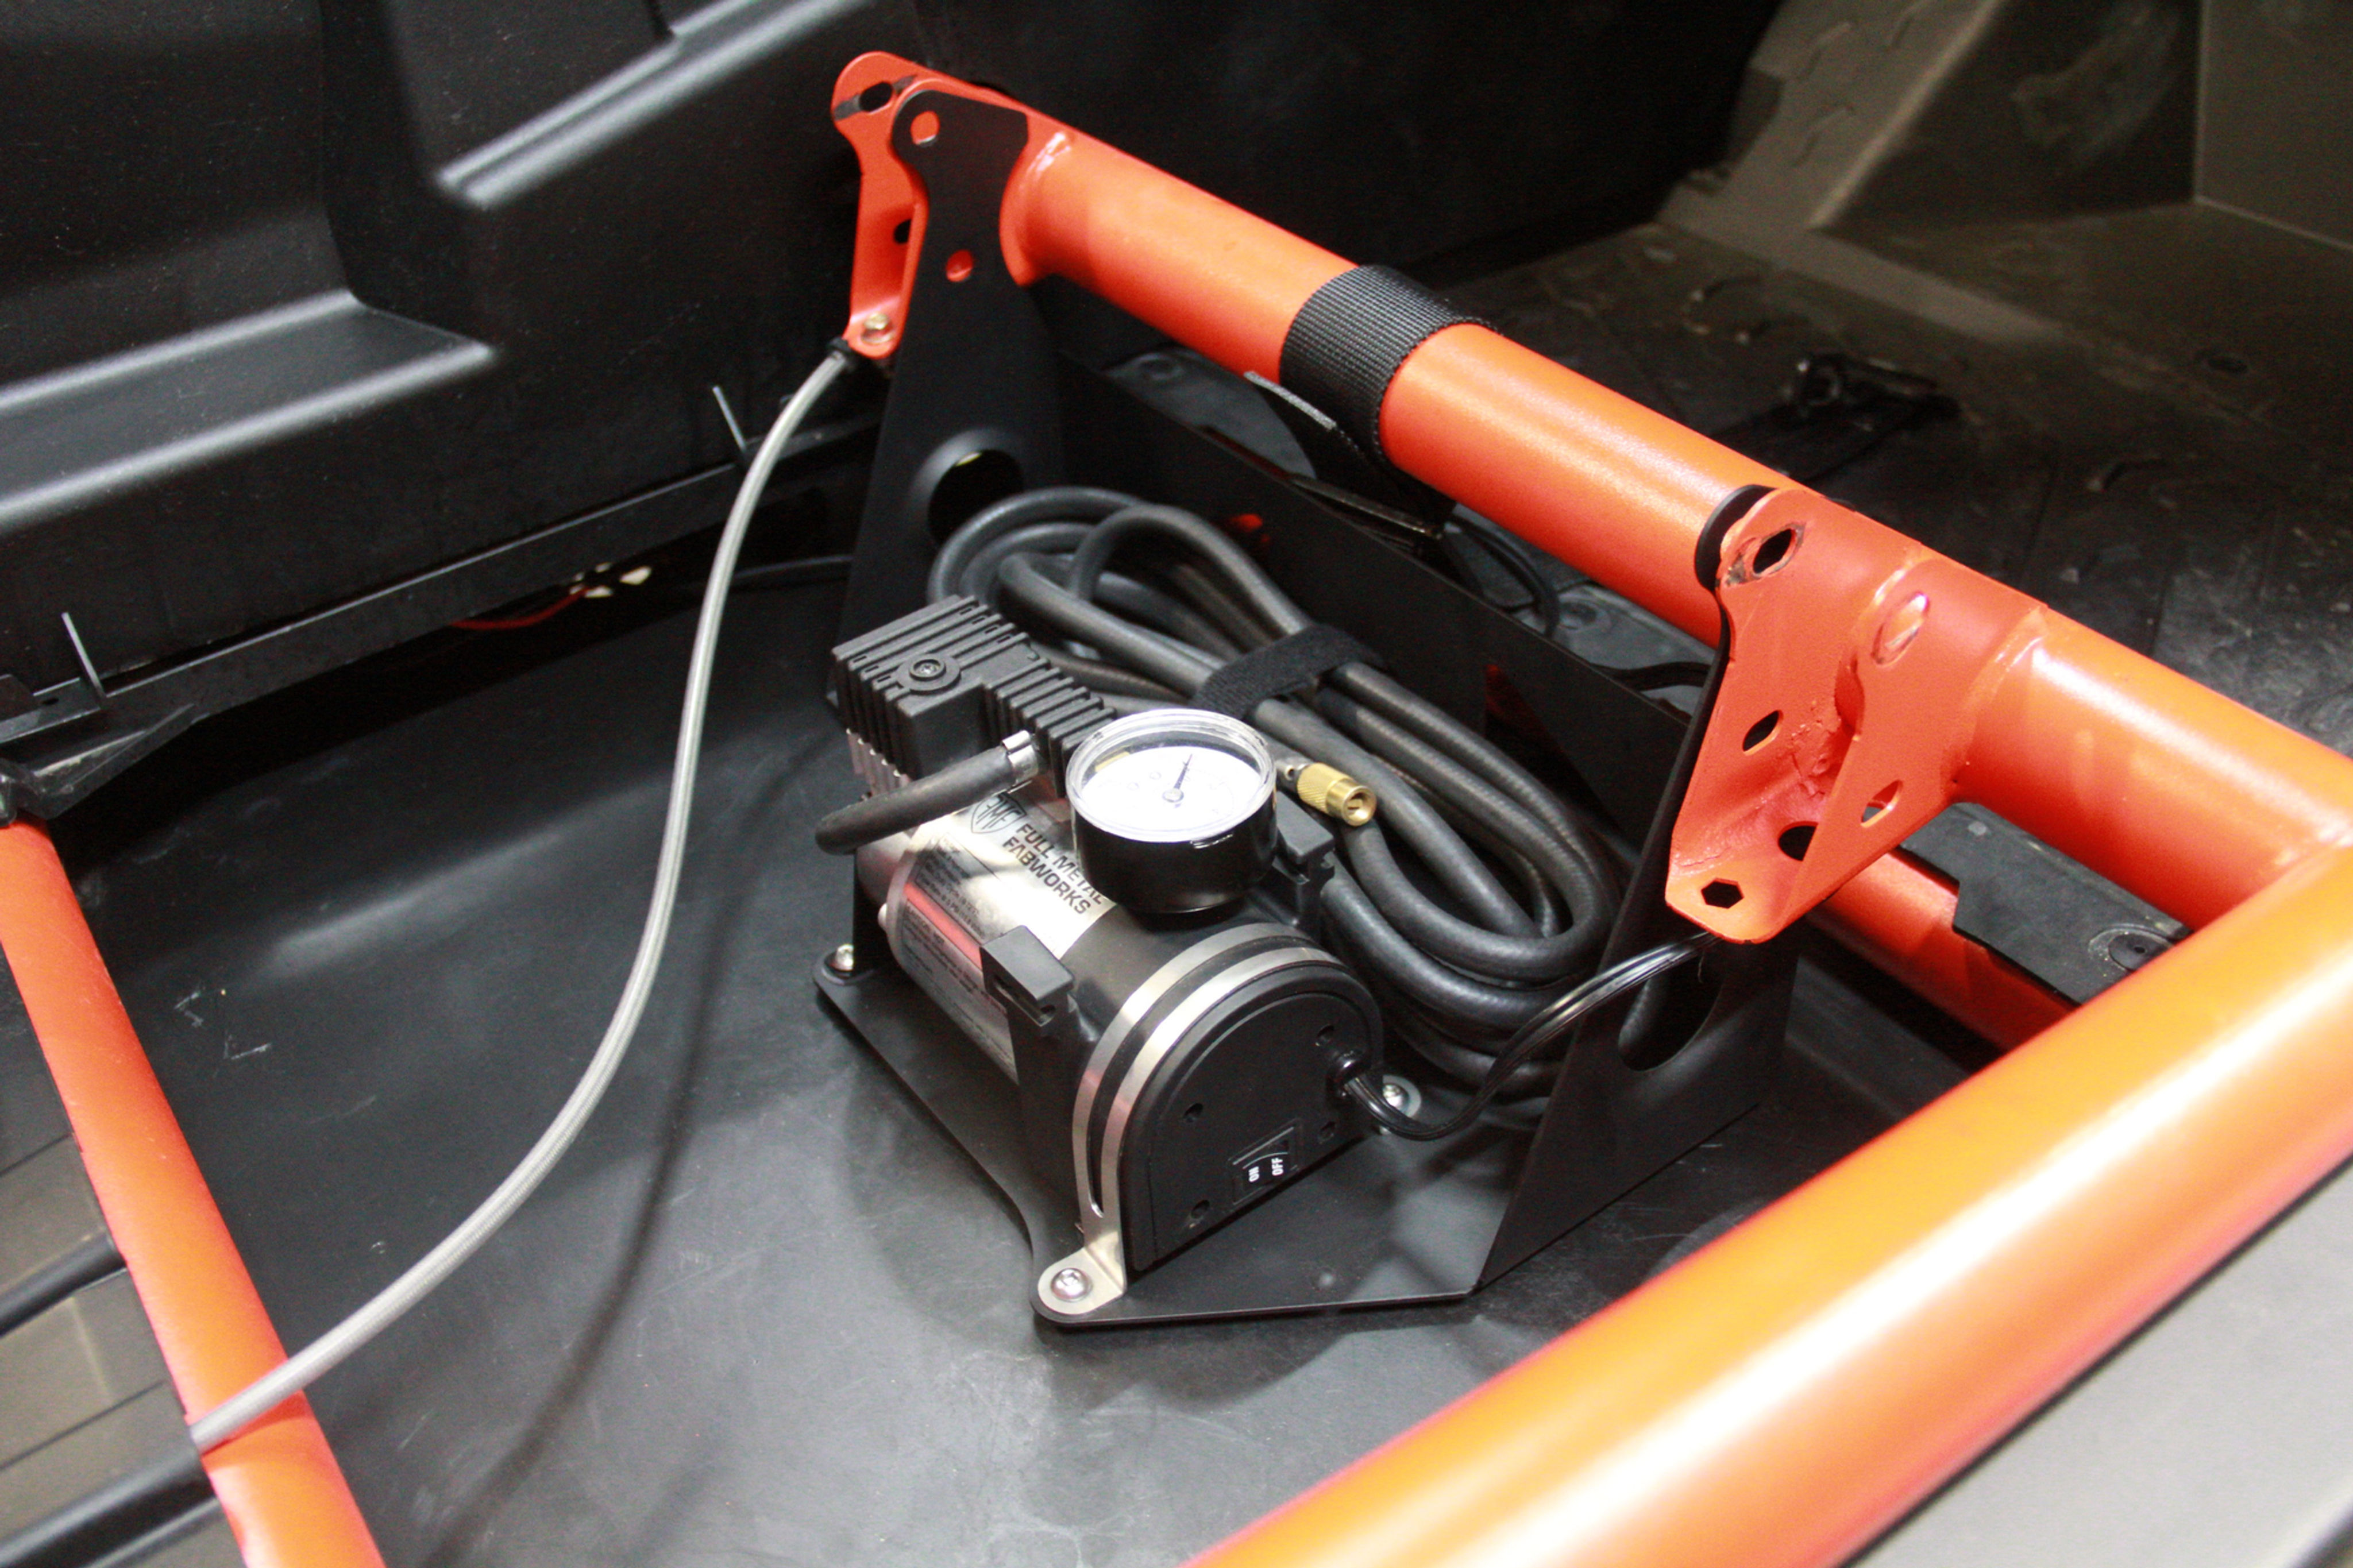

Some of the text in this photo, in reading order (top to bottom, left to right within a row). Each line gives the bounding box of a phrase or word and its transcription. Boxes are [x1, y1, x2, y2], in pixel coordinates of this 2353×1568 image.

[1015, 823, 1056, 859] FULL
[1002, 836, 1091, 914] FABWORKS
[1248, 1165, 1260, 1183] ON
[1271, 1157, 1284, 1176] OFF
